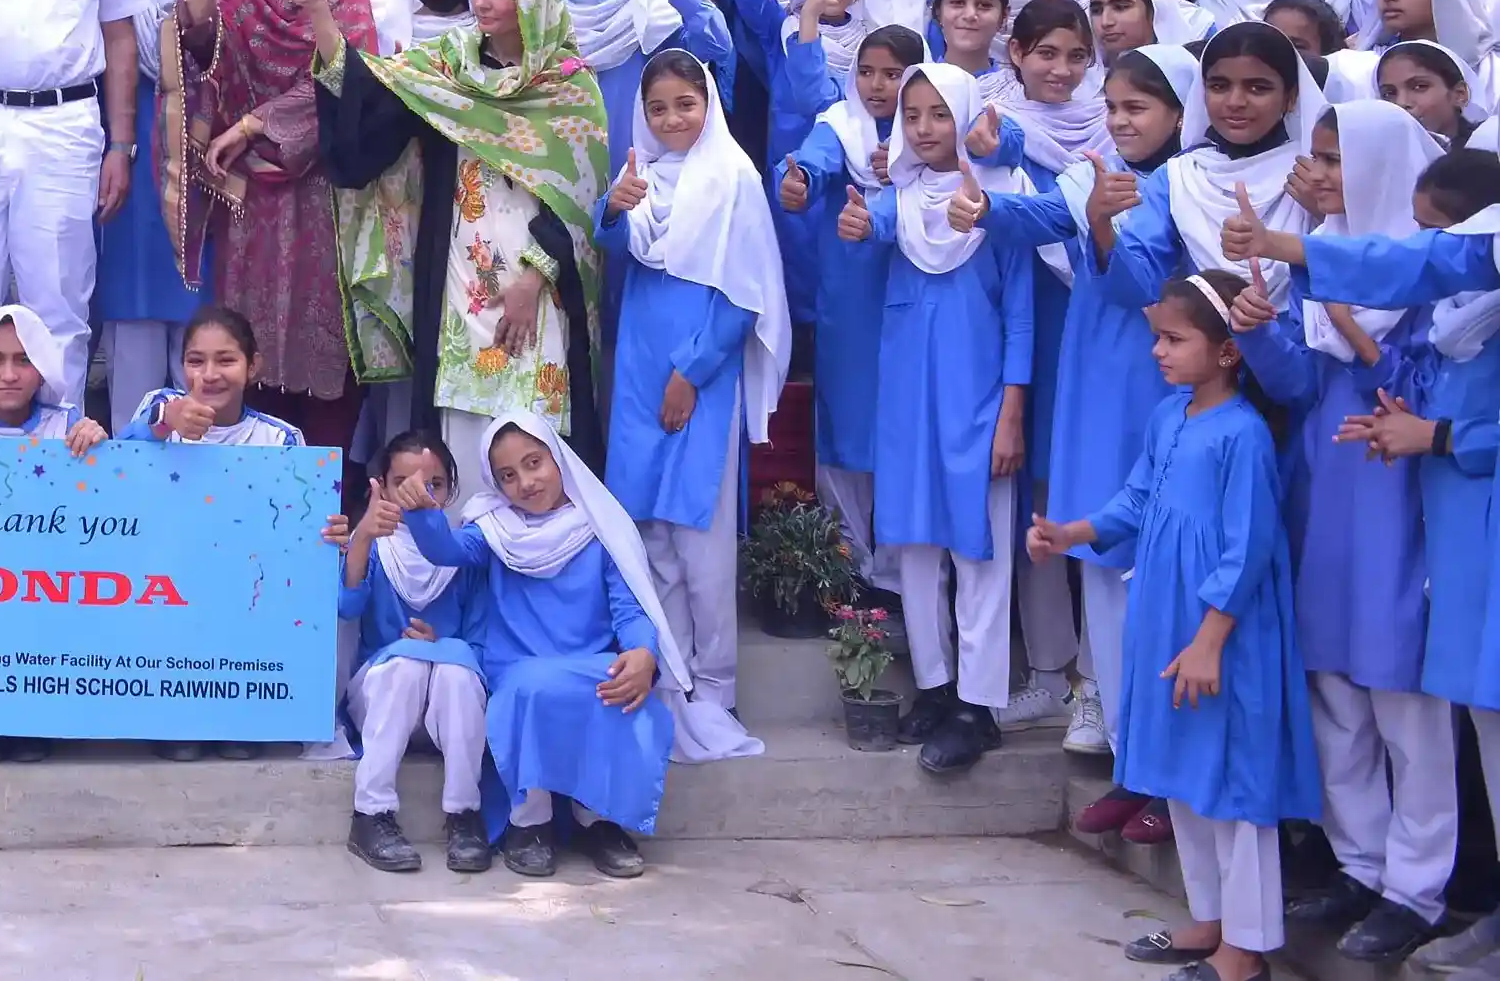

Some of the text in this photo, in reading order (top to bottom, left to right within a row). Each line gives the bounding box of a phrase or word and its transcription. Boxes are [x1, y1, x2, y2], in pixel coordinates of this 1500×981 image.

[79, 512, 141, 545] you
[15, 652, 57, 666] Water
[60, 653, 112, 671] Facility
[115, 655, 132, 669] At
[135, 655, 162, 669] Our
[166, 656, 215, 670] School
[219, 658, 284, 672] Premises
[23, 675, 70, 695] HIGH
[75, 676, 155, 697] SCHOOL
[160, 679, 240, 699] RAIWIND
[246, 681, 294, 701] PIND.
